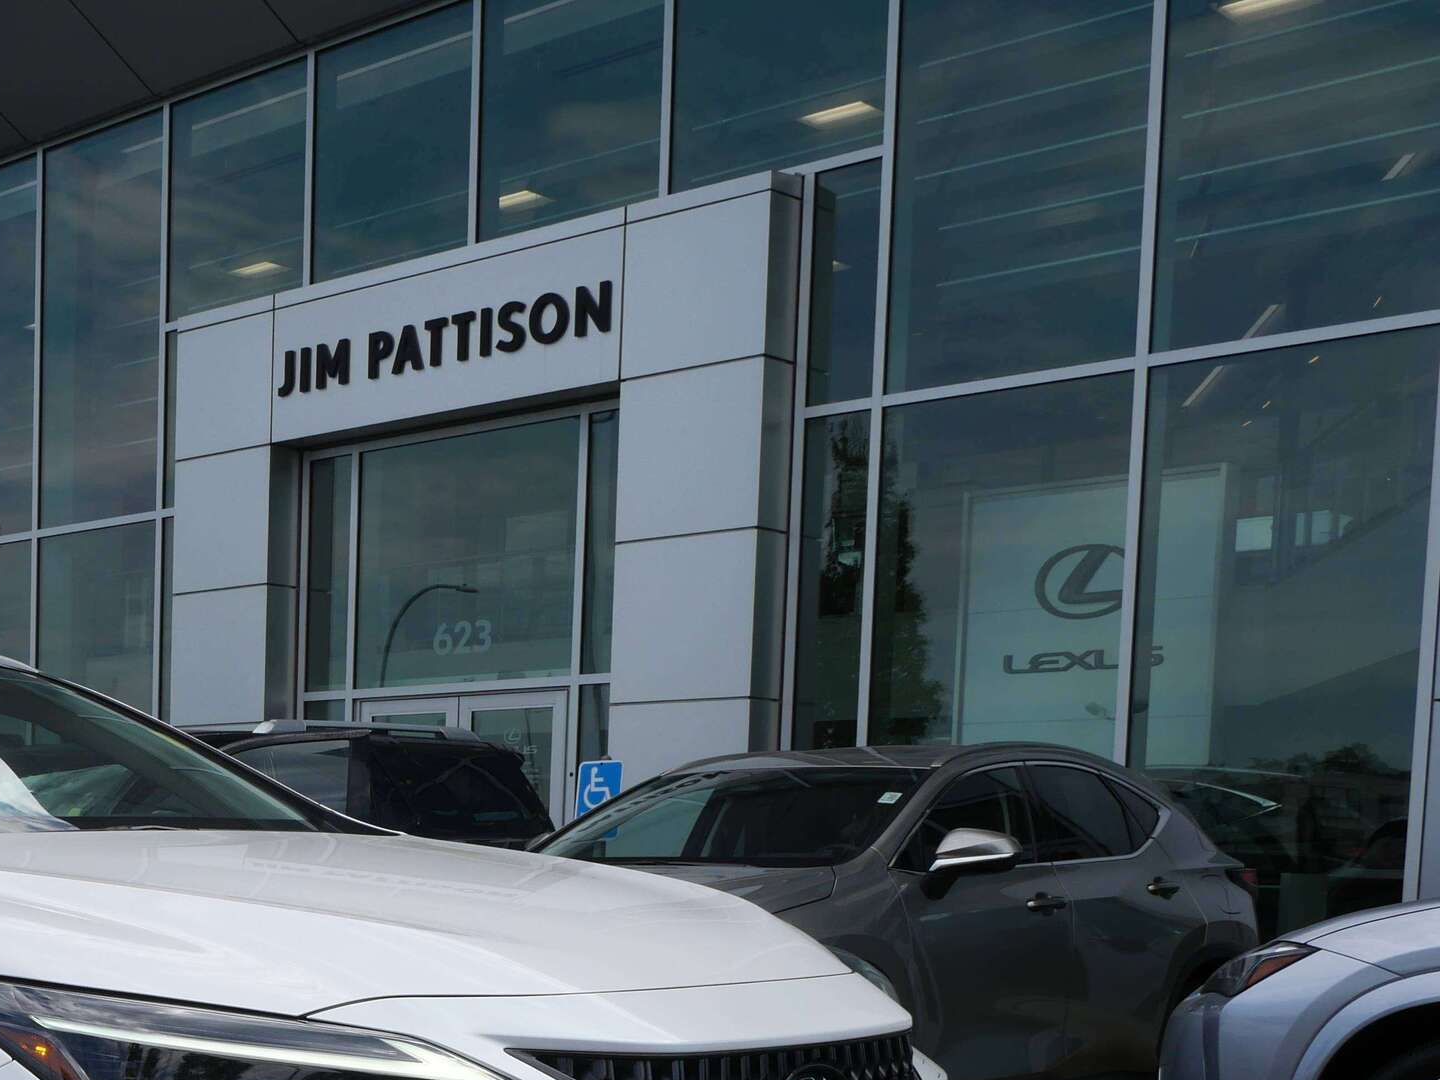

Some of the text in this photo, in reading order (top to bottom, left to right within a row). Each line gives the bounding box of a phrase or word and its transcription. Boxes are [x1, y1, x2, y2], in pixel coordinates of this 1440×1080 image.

[278, 279, 613, 398] JIM PATTISON
[432, 619, 492, 656] 623
